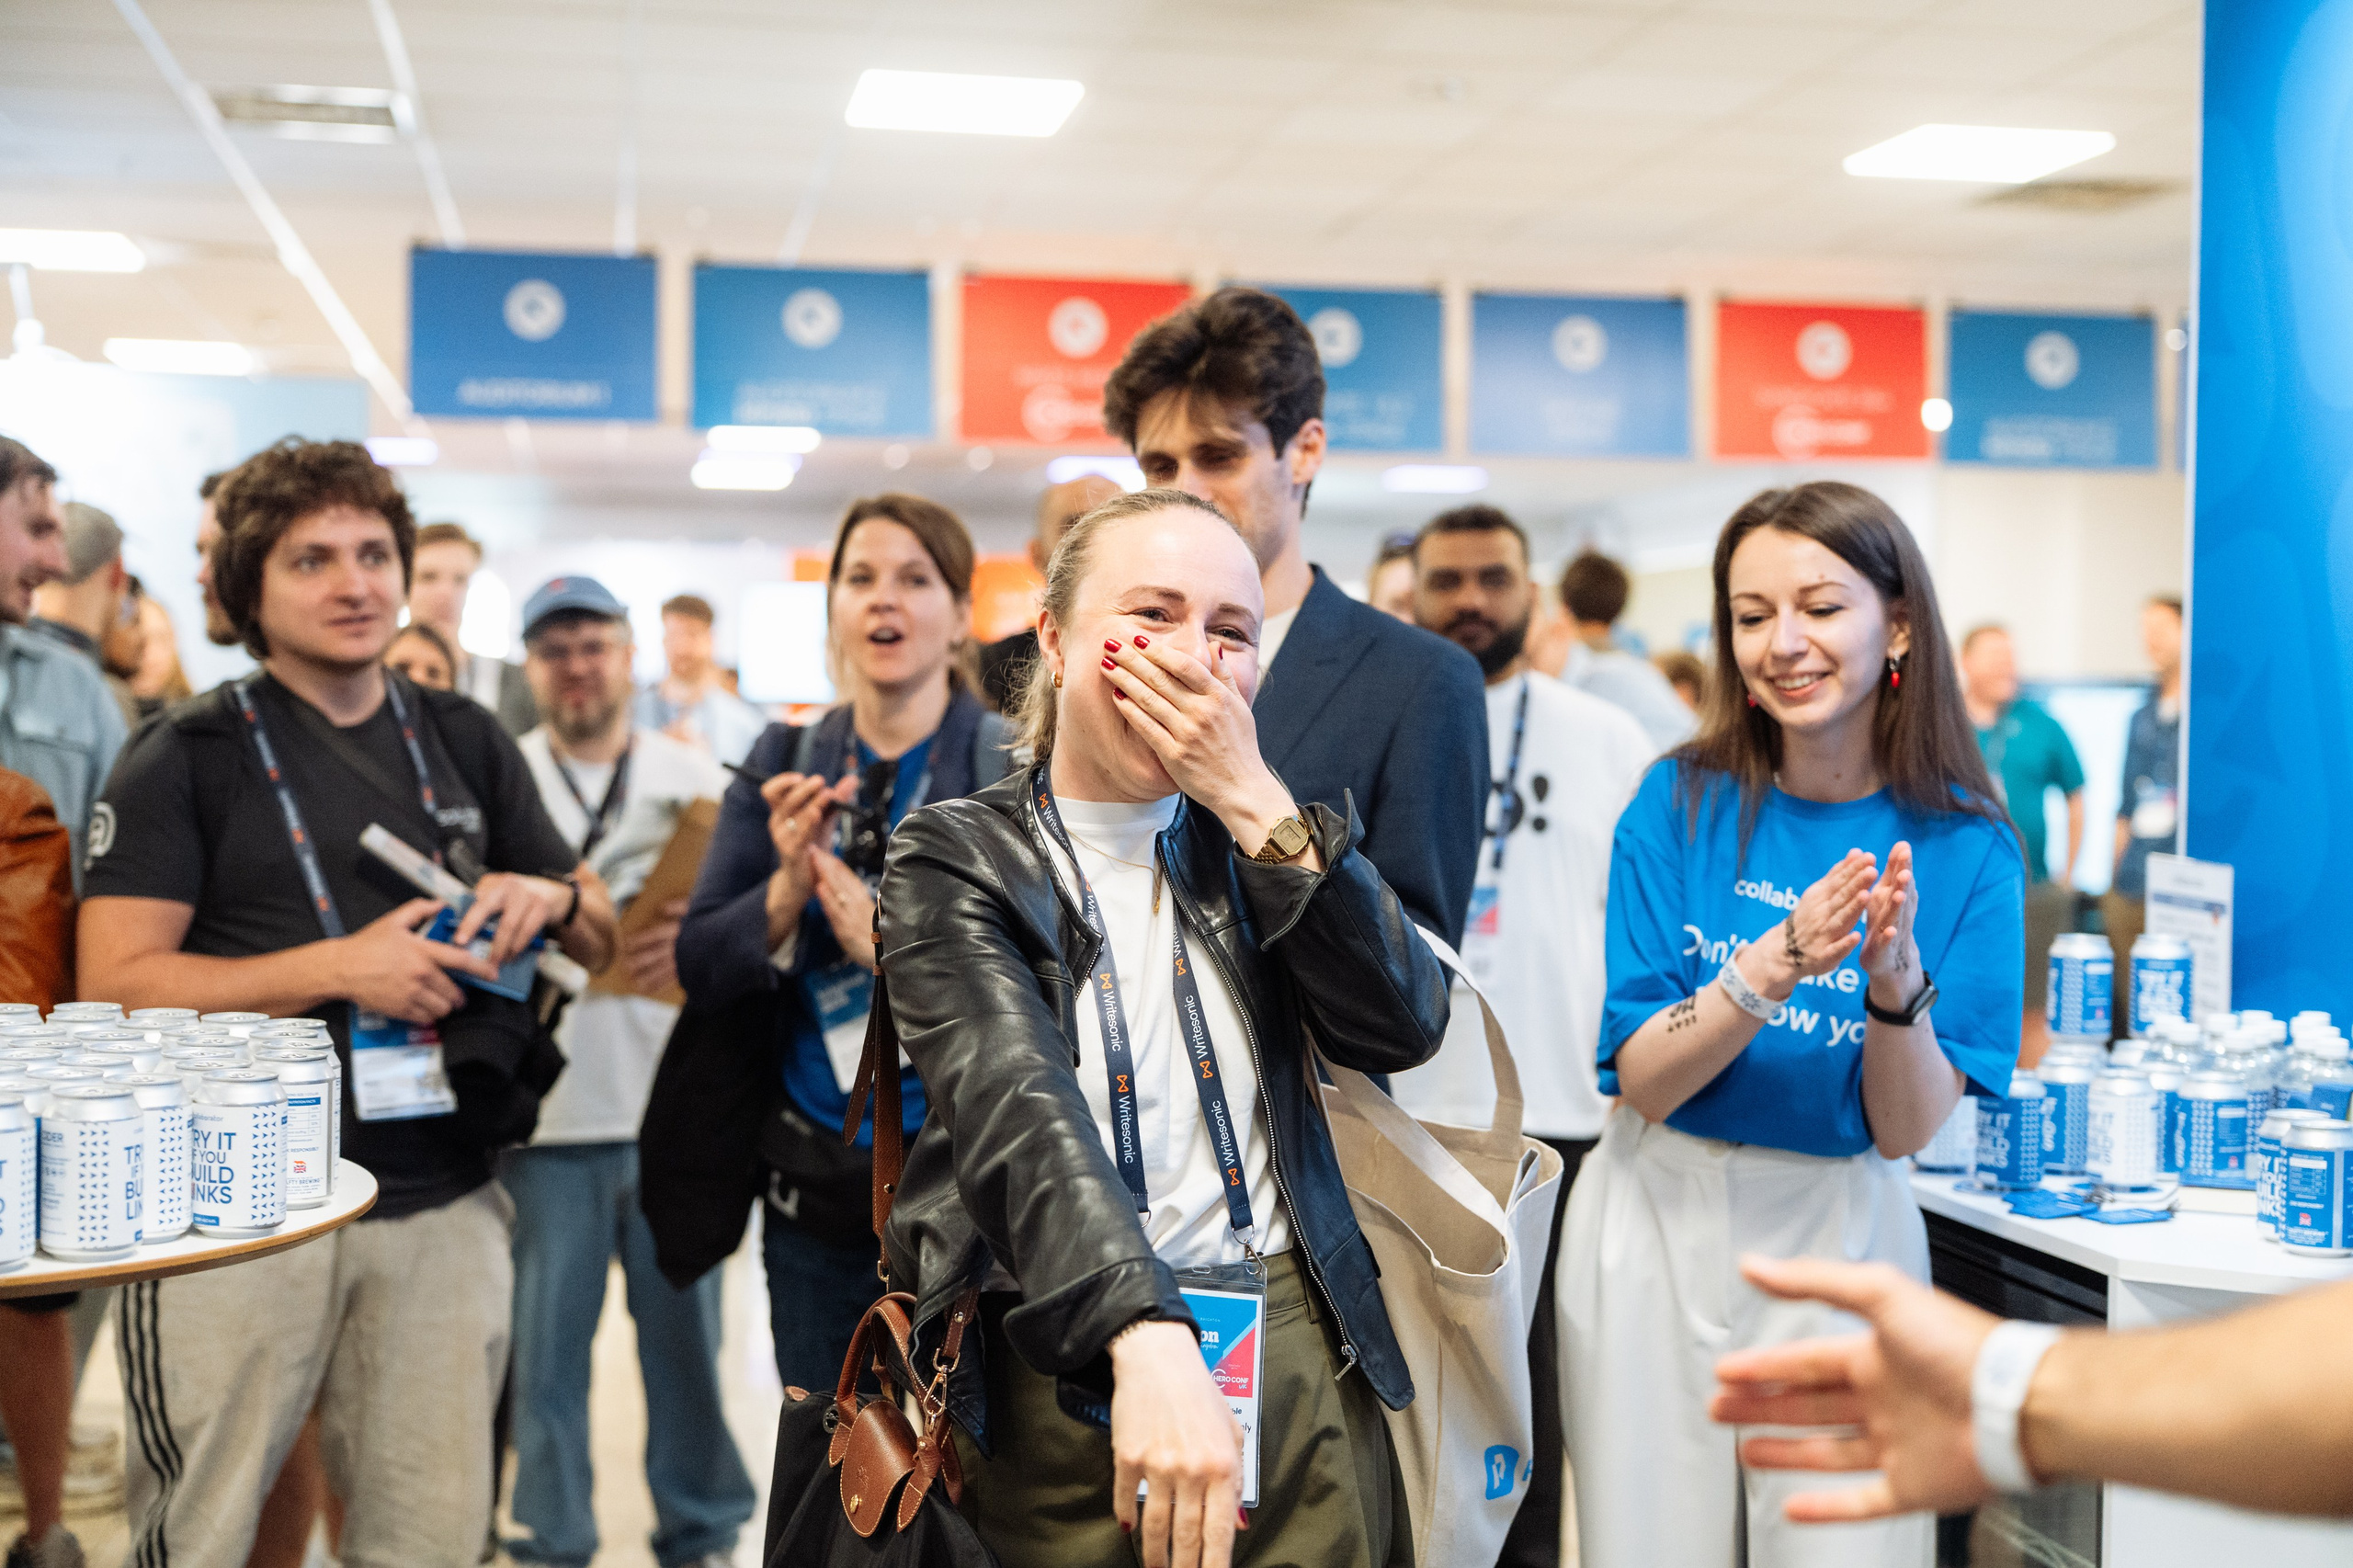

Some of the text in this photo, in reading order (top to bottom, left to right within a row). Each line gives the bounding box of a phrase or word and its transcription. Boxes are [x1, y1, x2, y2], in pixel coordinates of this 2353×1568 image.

[1734, 880, 1802, 911] collab
[1683, 924, 1749, 965] Don'
[1799, 968, 1859, 994] ke
[1103, 991, 1123, 1051] Writesonic
[1186, 994, 1208, 1060] Writesonic
[1767, 1006, 1866, 1047] ow yo
[193, 1129, 236, 1150] RY IT
[1119, 1095, 1136, 1164] Writesonic
[1211, 1100, 1234, 1166] Writesonic
[124, 1145, 142, 1165] TR
[199, 1151, 226, 1165] YOU
[192, 1164, 234, 1184] UILD
[191, 1183, 233, 1205] INKS
[127, 1200, 142, 1221] LIN
[1200, 1330, 1220, 1344] on
[1213, 1375, 1231, 1383] HERO
